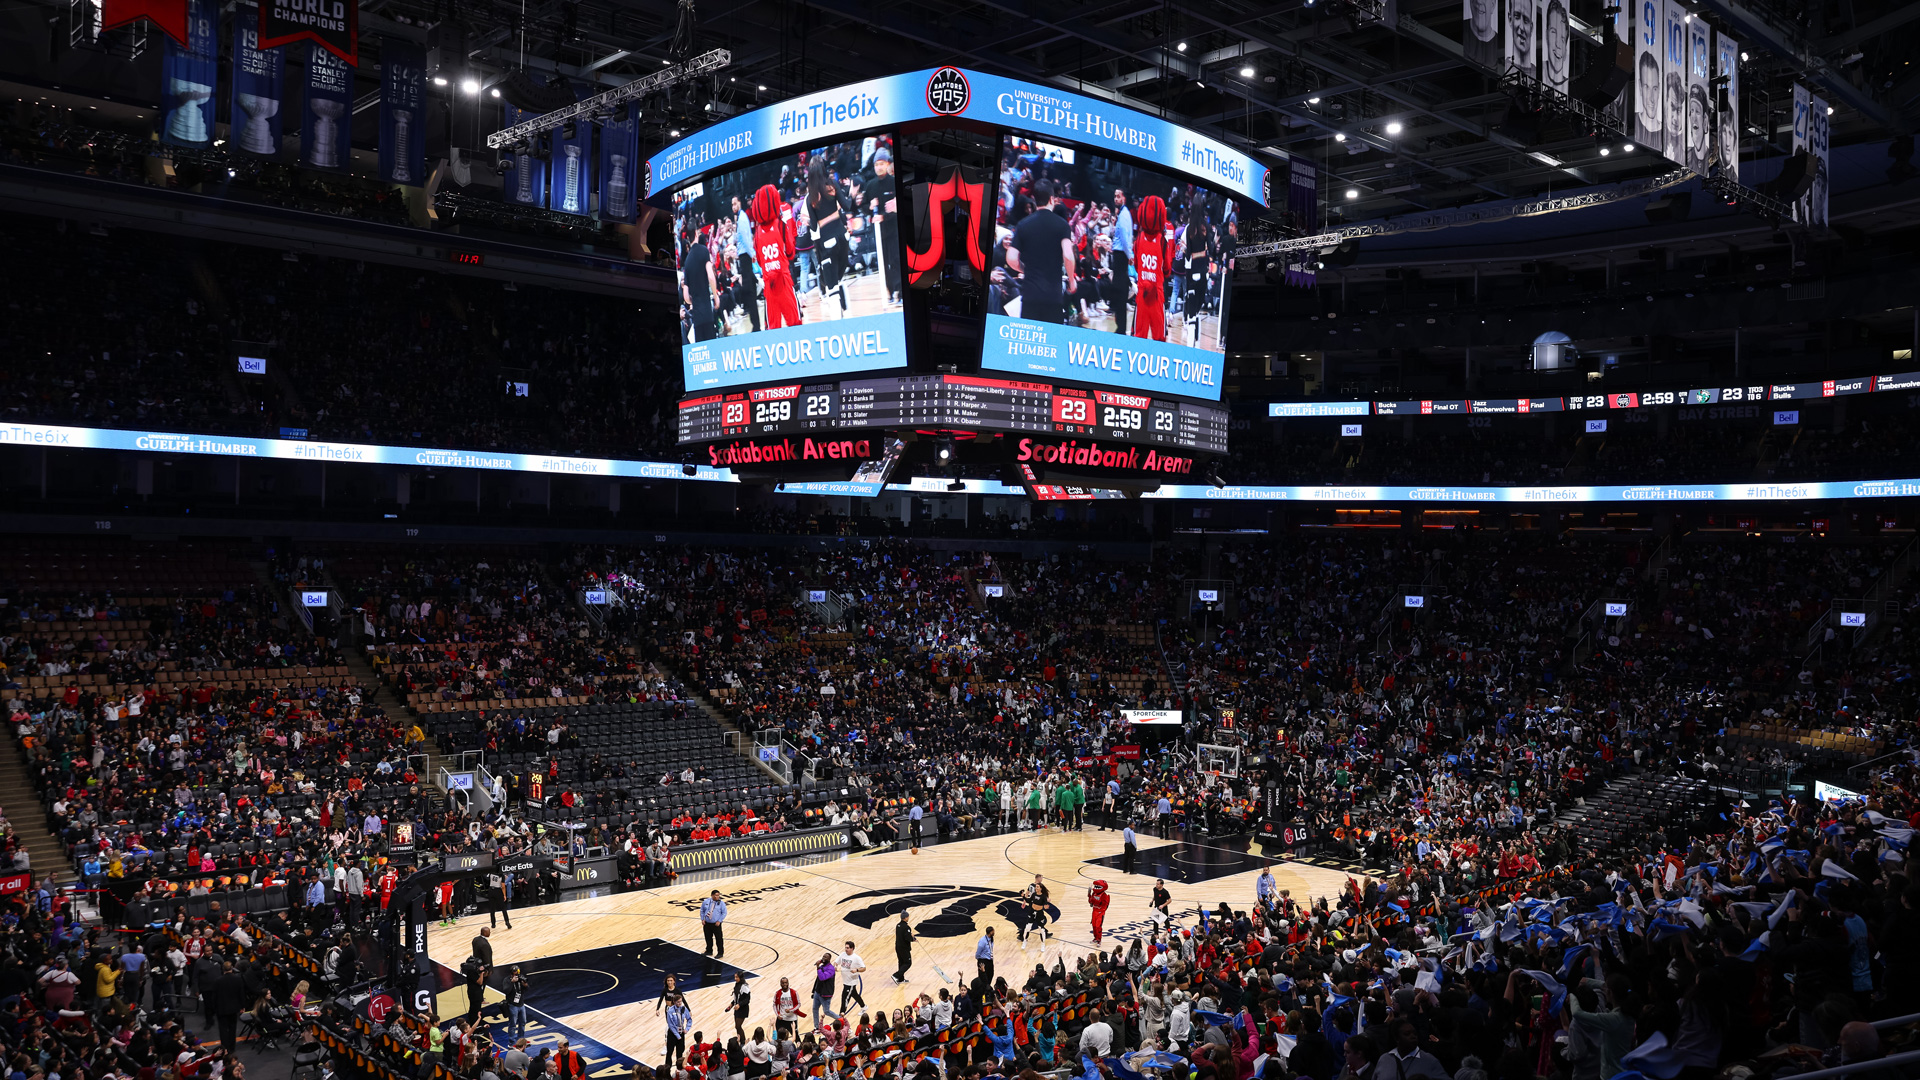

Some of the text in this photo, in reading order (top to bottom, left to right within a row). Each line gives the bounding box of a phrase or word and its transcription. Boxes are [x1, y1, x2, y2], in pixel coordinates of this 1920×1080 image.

[274, 8, 345, 31] CHAMPIONS
[1644, 1, 1655, 46] 9
[1668, 19, 1682, 67] 10
[1692, 32, 1707, 79] 13
[312, 66, 347, 78] STANLEY
[321, 74, 337, 84] CUP
[934, 82, 963, 92] RAPTORS
[932, 90, 963, 107] 905
[1014, 89, 1072, 110] UNIVERSITY OF
[779, 93, 880, 136] #InThe6ix
[996, 92, 1157, 152] GUELPH-HUMBER
[1814, 112, 1828, 152] 93
[659, 130, 753, 182] GUELPH-HUMBER
[1181, 140, 1245, 186] #InThe6ix
[999, 324, 1047, 344] GUELPH
[721, 329, 890, 373] WAVE YOUR TOWEL
[1008, 341, 1057, 359] HUMBER
[244, 360, 260, 371] Bell
[1068, 340, 1215, 388] WAVE YOUR TOWEL
[765, 386, 797, 400] TISSOT
[961, 385, 1005, 396] Freeman-Liberty
[1773, 385, 1796, 393] Bucks
[1835, 382, 1862, 392] Final OT
[1642, 392, 1675, 406] 2:59
[1723, 388, 1743, 401] 23
[806, 394, 830, 417] 23
[961, 401, 980, 410] Harper
[1115, 394, 1148, 408] TISSOT
[1473, 400, 1487, 408] Jazz
[1586, 395, 1605, 408] 23
[727, 403, 743, 424] 23
[756, 401, 791, 423] 2:59
[1061, 399, 1087, 422] 23
[1275, 405, 1363, 416] GUELPH-HUMBER
[1678, 405, 1761, 421] BAY STREET
[809, 419, 836, 428] 03 6
[960, 418, 982, 426] Obanor
[1103, 407, 1142, 431] 2:59
[1155, 410, 1174, 432] 23
[1779, 413, 1794, 422] Bell
[763, 424, 773, 433] QTR
[1066, 425, 1074, 433] 03
[1089, 427, 1093, 435] 6
[1112, 430, 1124, 438] QTR
[1346, 426, 1358, 434] Bell
[136, 435, 258, 456] GUELPH-HUMBER
[295, 444, 363, 460] #InThe6ix
[709, 438, 871, 466] Scotiabank Arena
[1017, 438, 1193, 474] Scotiabank Arena
[415, 452, 512, 469] GUELPH-HUMBER
[541, 458, 598, 474] #InThe6ix
[640, 465, 720, 481] GUELPH-MBER
[806, 482, 873, 494] WAVE YOUR TOWEL
[1314, 488, 1366, 499] #InThe6ix
[1524, 488, 1577, 500] #InThe6ix
[1622, 488, 1715, 499] GUELPH-HUMBER
[1747, 486, 1808, 498] #InThe6ix
[1206, 489, 1287, 500] GUELPH-HUMBER
[1408, 489, 1496, 500] GUELPH-HUMBER
[95, 521, 111, 530] 118
[406, 528, 419, 537] 119
[307, 594, 322, 604] Bell
[590, 593, 602, 602] Bell
[812, 591, 823, 600] Bell
[1203, 591, 1214, 599] Bell
[1409, 597, 1419, 605] Bell
[1610, 605, 1622, 614] Bell
[1846, 615, 1860, 624] Bell
[1222, 710, 1234, 718] 2:59
[1223, 717, 1233, 728] 17
[532, 784, 542, 800] 17
[1294, 828, 1307, 841] LG
[501, 862, 534, 873] Uber Eats
[6, 878, 22, 890] all
[386, 880, 391, 889] 1
[667, 882, 804, 906] Sciabank
[415, 923, 424, 953] AXE
